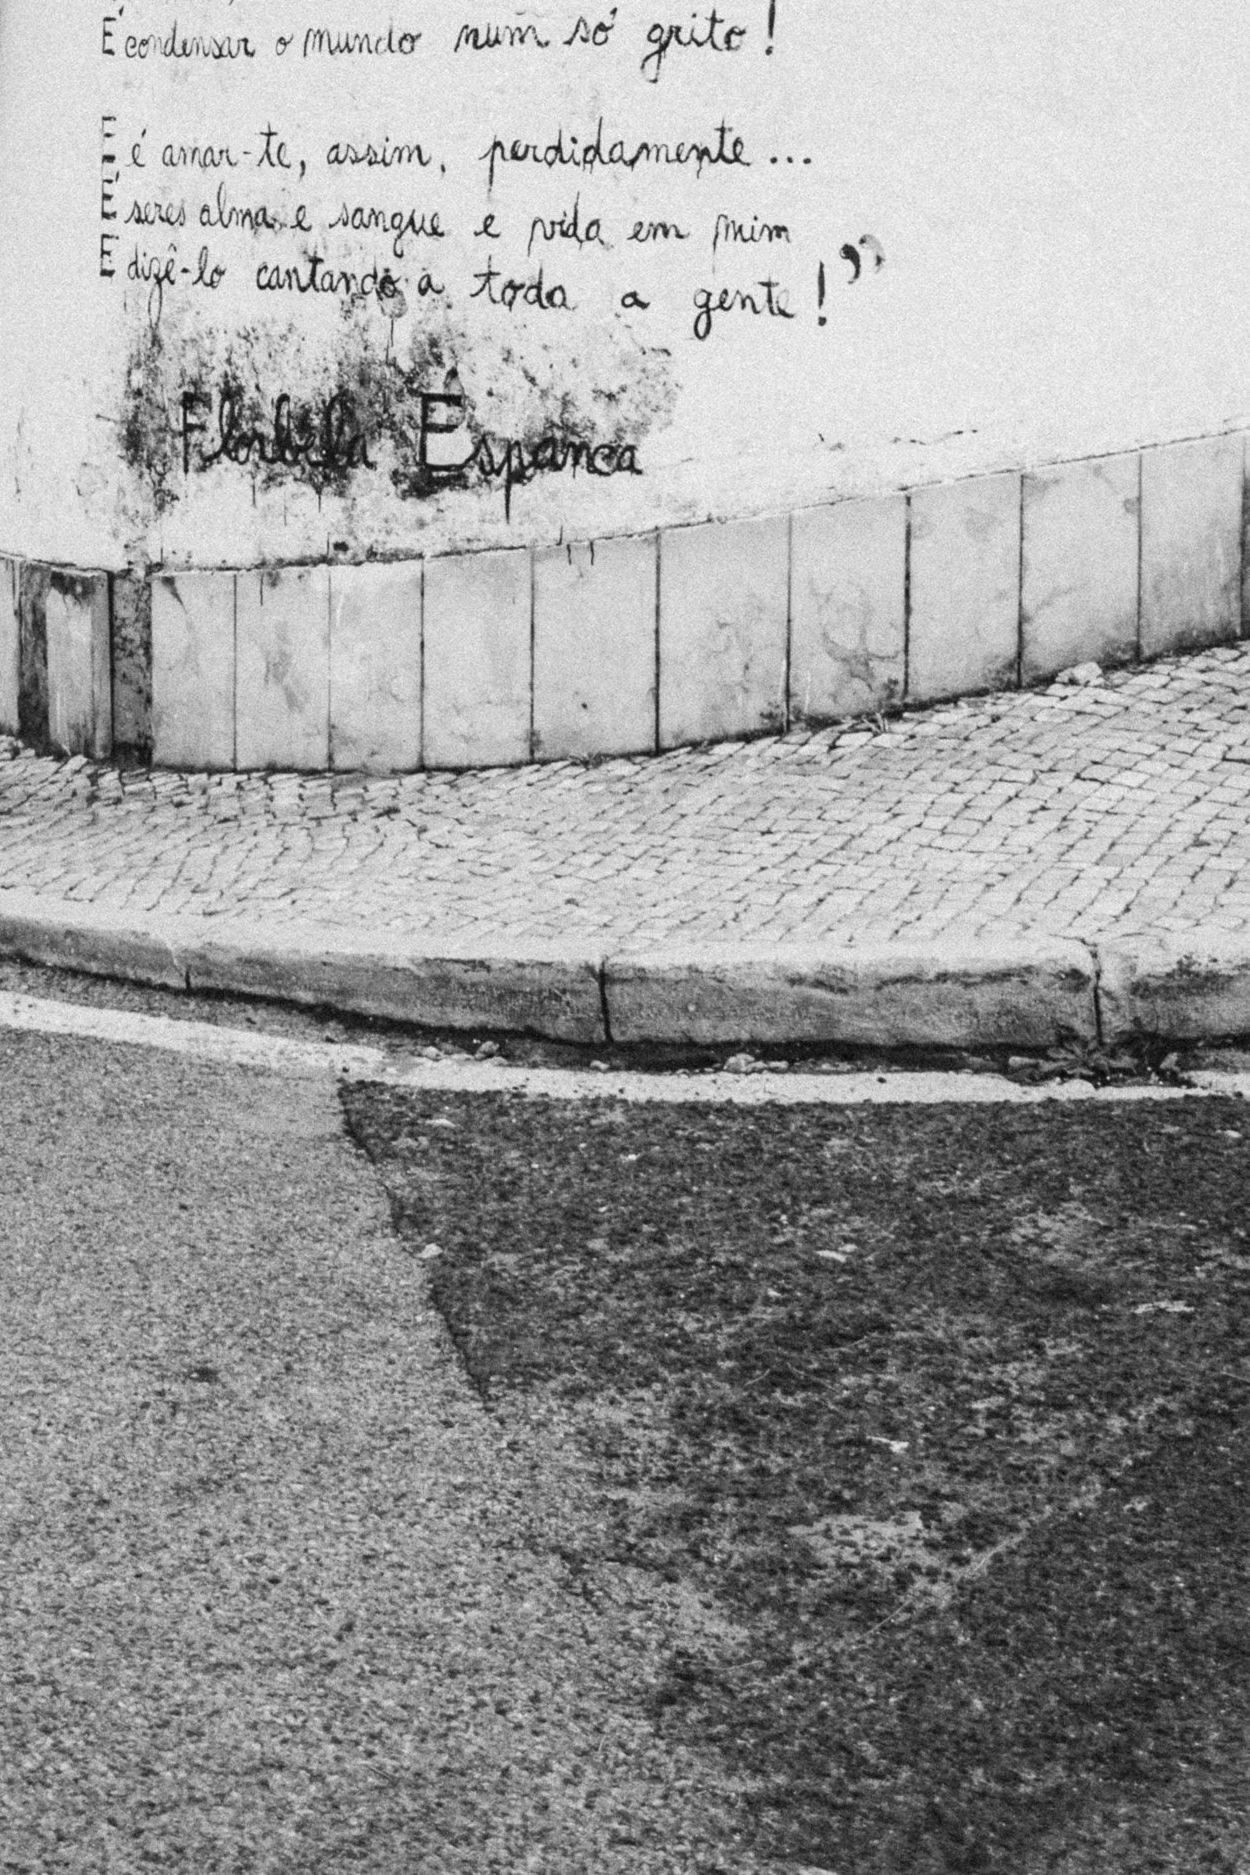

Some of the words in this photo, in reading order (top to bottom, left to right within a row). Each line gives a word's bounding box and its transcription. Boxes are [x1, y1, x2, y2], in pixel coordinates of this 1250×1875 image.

[125, 19, 257, 60] condensar
[275, 33, 295, 57] o
[304, 22, 423, 59] mundo
[562, 6, 619, 48] só
[124, 127, 148, 168] é
[123, 197, 187, 227] seres
[199, 180, 277, 230] alma
[289, 203, 313, 233] e
[328, 201, 446, 259] sangue
[473, 212, 502, 241] e
[527, 190, 608, 258] vida
[627, 217, 690, 243] em
[712, 213, 792, 266] mim
[100, 232, 120, 277] E
[468, 253, 576, 312] toda
[620, 289, 651, 311] a
